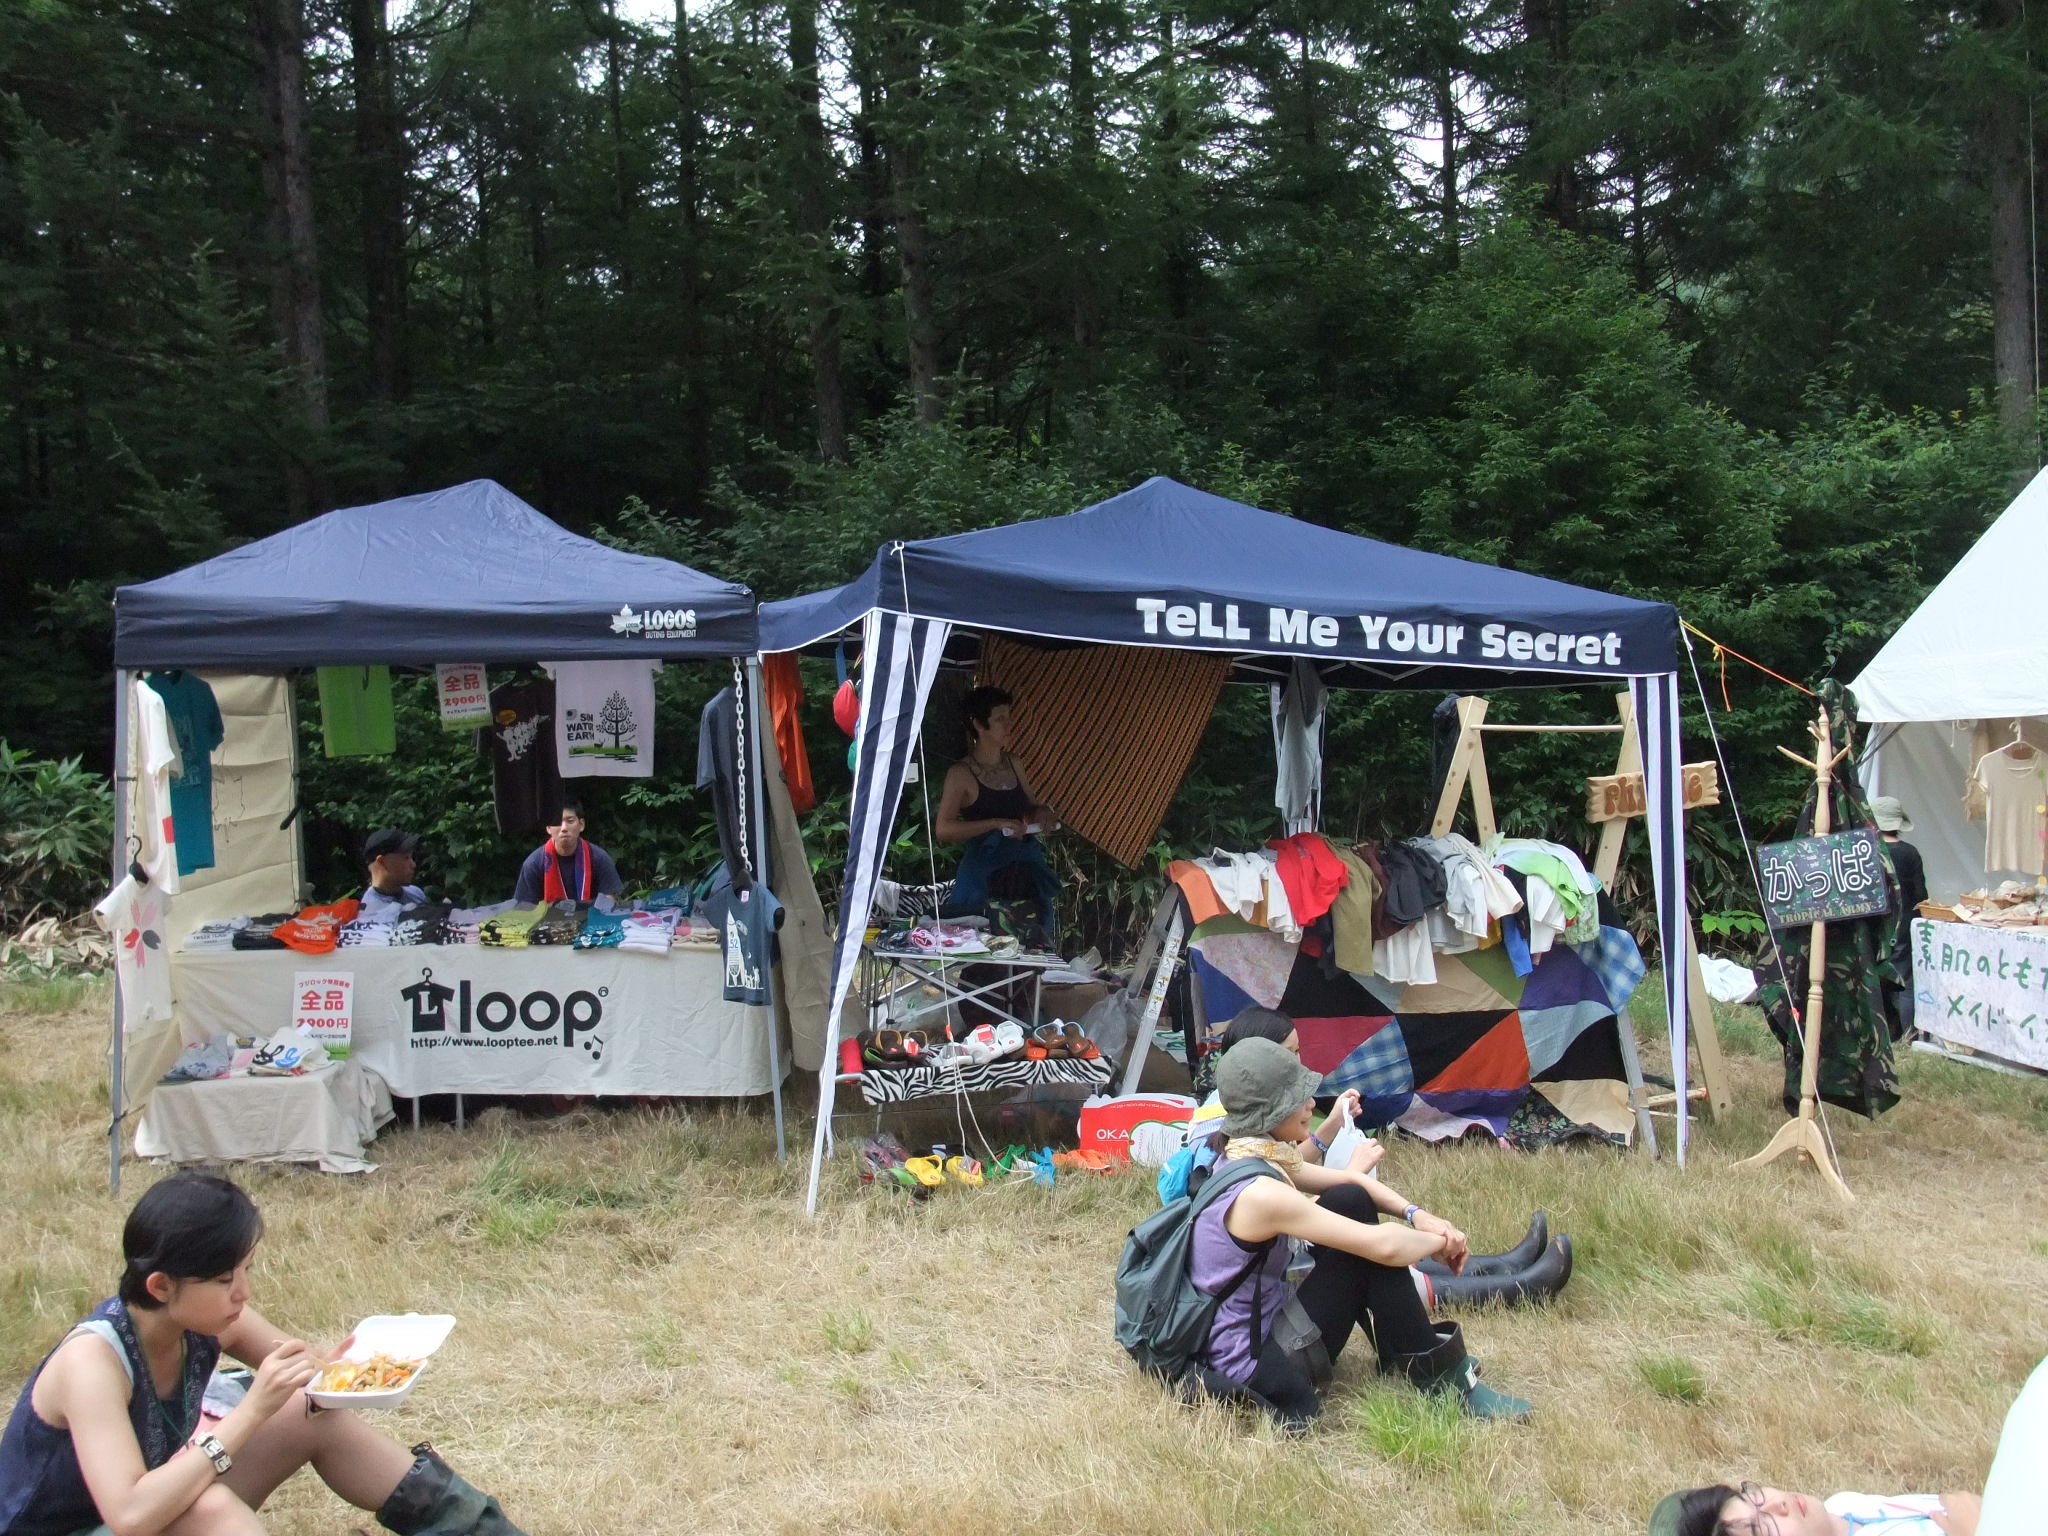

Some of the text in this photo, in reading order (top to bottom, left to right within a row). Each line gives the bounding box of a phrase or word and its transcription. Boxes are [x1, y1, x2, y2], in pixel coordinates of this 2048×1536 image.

[644, 609, 697, 630] LOGOS
[666, 629, 697, 638] EQUIPMENT
[1136, 598, 1622, 667] TeLL Me Your Secret
[444, 673, 481, 692] 全品
[444, 694, 486, 706] 2900円
[1764, 840, 1872, 903] かっぱ
[1779, 901, 1873, 924] TROPICAL ARMY
[300, 990, 344, 1011] 全品
[418, 980, 603, 1047] L loop
[411, 1035, 558, 1049] http://www.looptee.net
